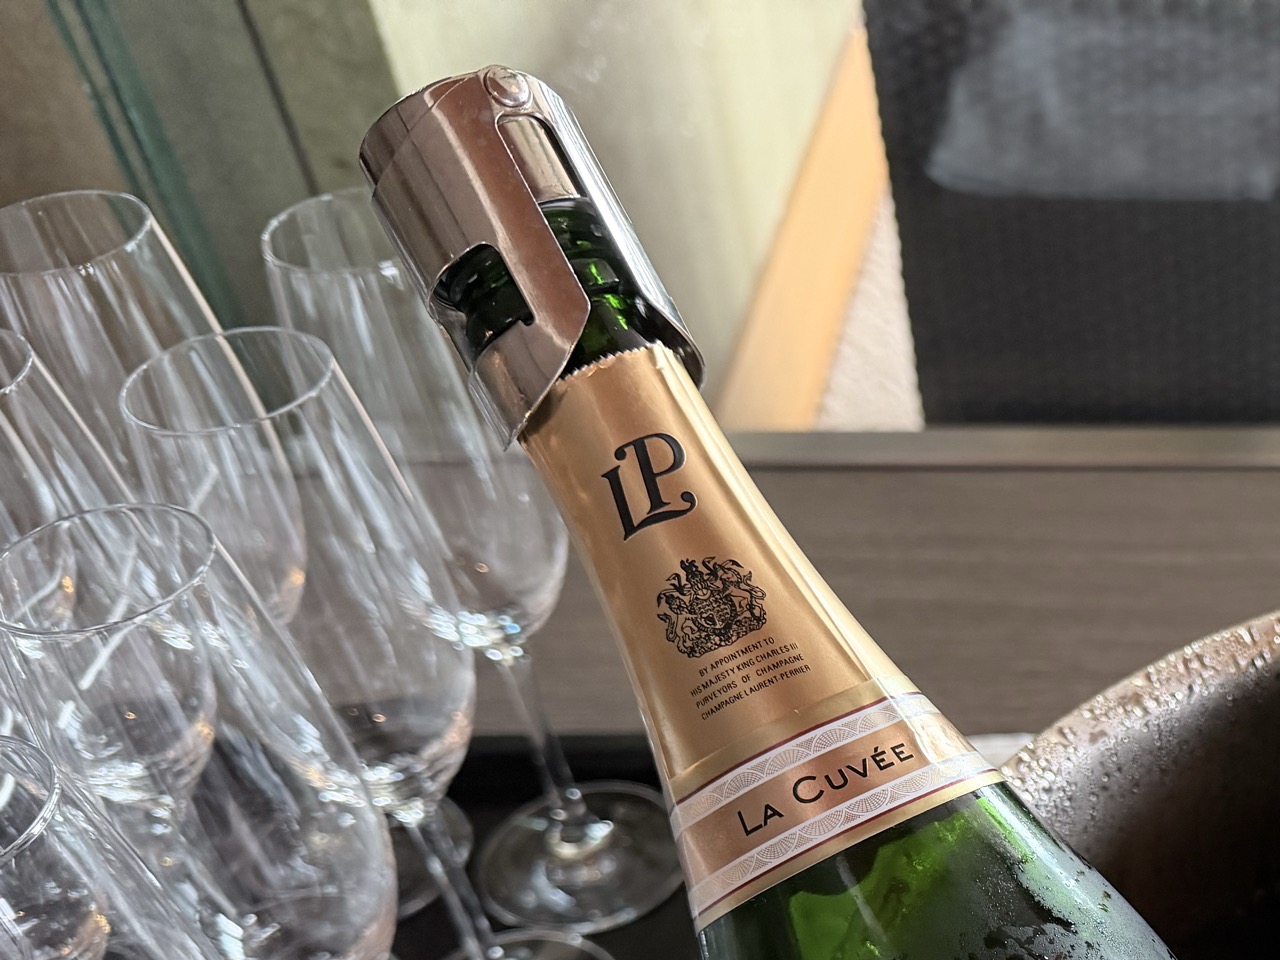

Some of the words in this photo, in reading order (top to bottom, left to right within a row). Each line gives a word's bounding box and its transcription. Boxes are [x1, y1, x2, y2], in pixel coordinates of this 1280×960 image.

[601, 433, 696, 541] LP
[690, 686, 703, 697] HIS
[701, 668, 735, 691] MAJESTY
[736, 659, 756, 672] KING
[755, 644, 790, 663] CHARLES
[789, 642, 799, 651] III
[695, 681, 738, 710] PURVEYORS
[741, 674, 751, 684] OF
[755, 653, 804, 677] CHAMPAGNE
[698, 666, 709, 678] BY
[710, 642, 763, 671] APPOINTMENT
[763, 636, 775, 646] TO
[700, 692, 744, 721] CHAMPAGNE
[745, 664, 811, 697] LAURENT-PERRIER
[737, 804, 784, 836] LA
[793, 743, 913, 803] CUVÉE
